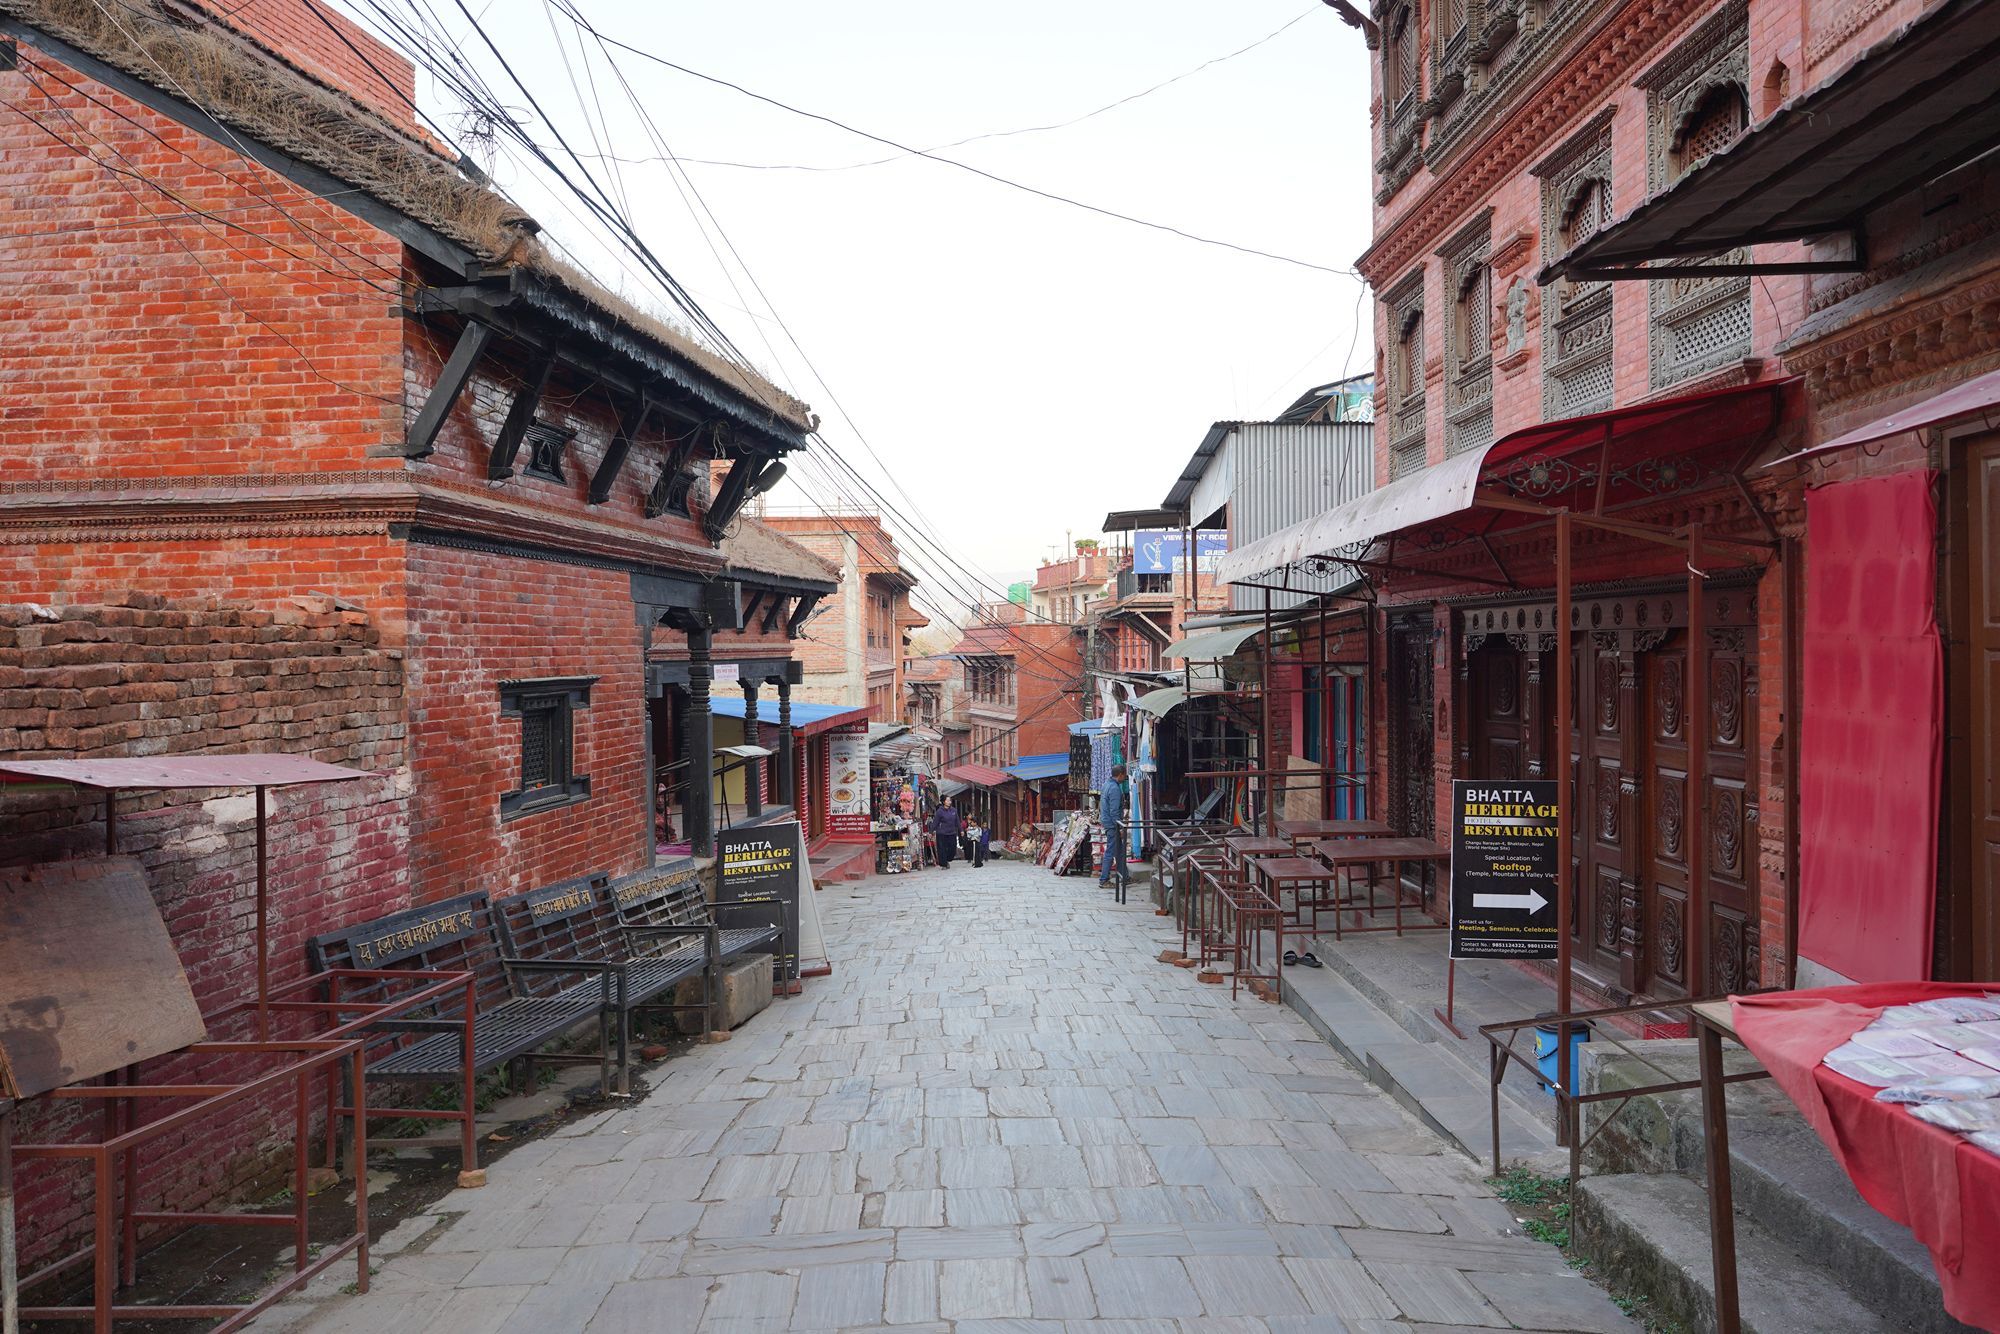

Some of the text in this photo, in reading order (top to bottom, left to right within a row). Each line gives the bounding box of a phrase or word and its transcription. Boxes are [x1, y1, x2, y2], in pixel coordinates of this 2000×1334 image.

[1466, 789, 1534, 802] BHATTA
[1464, 803, 1559, 817] HERITAGE
[1464, 825, 1559, 837] RESTAURANT
[725, 840, 772, 854] BHATTA
[724, 848, 791, 862] HERITAGE
[724, 862, 792, 876] RESTAURANT
[1492, 862, 1532, 872] Rooftop
